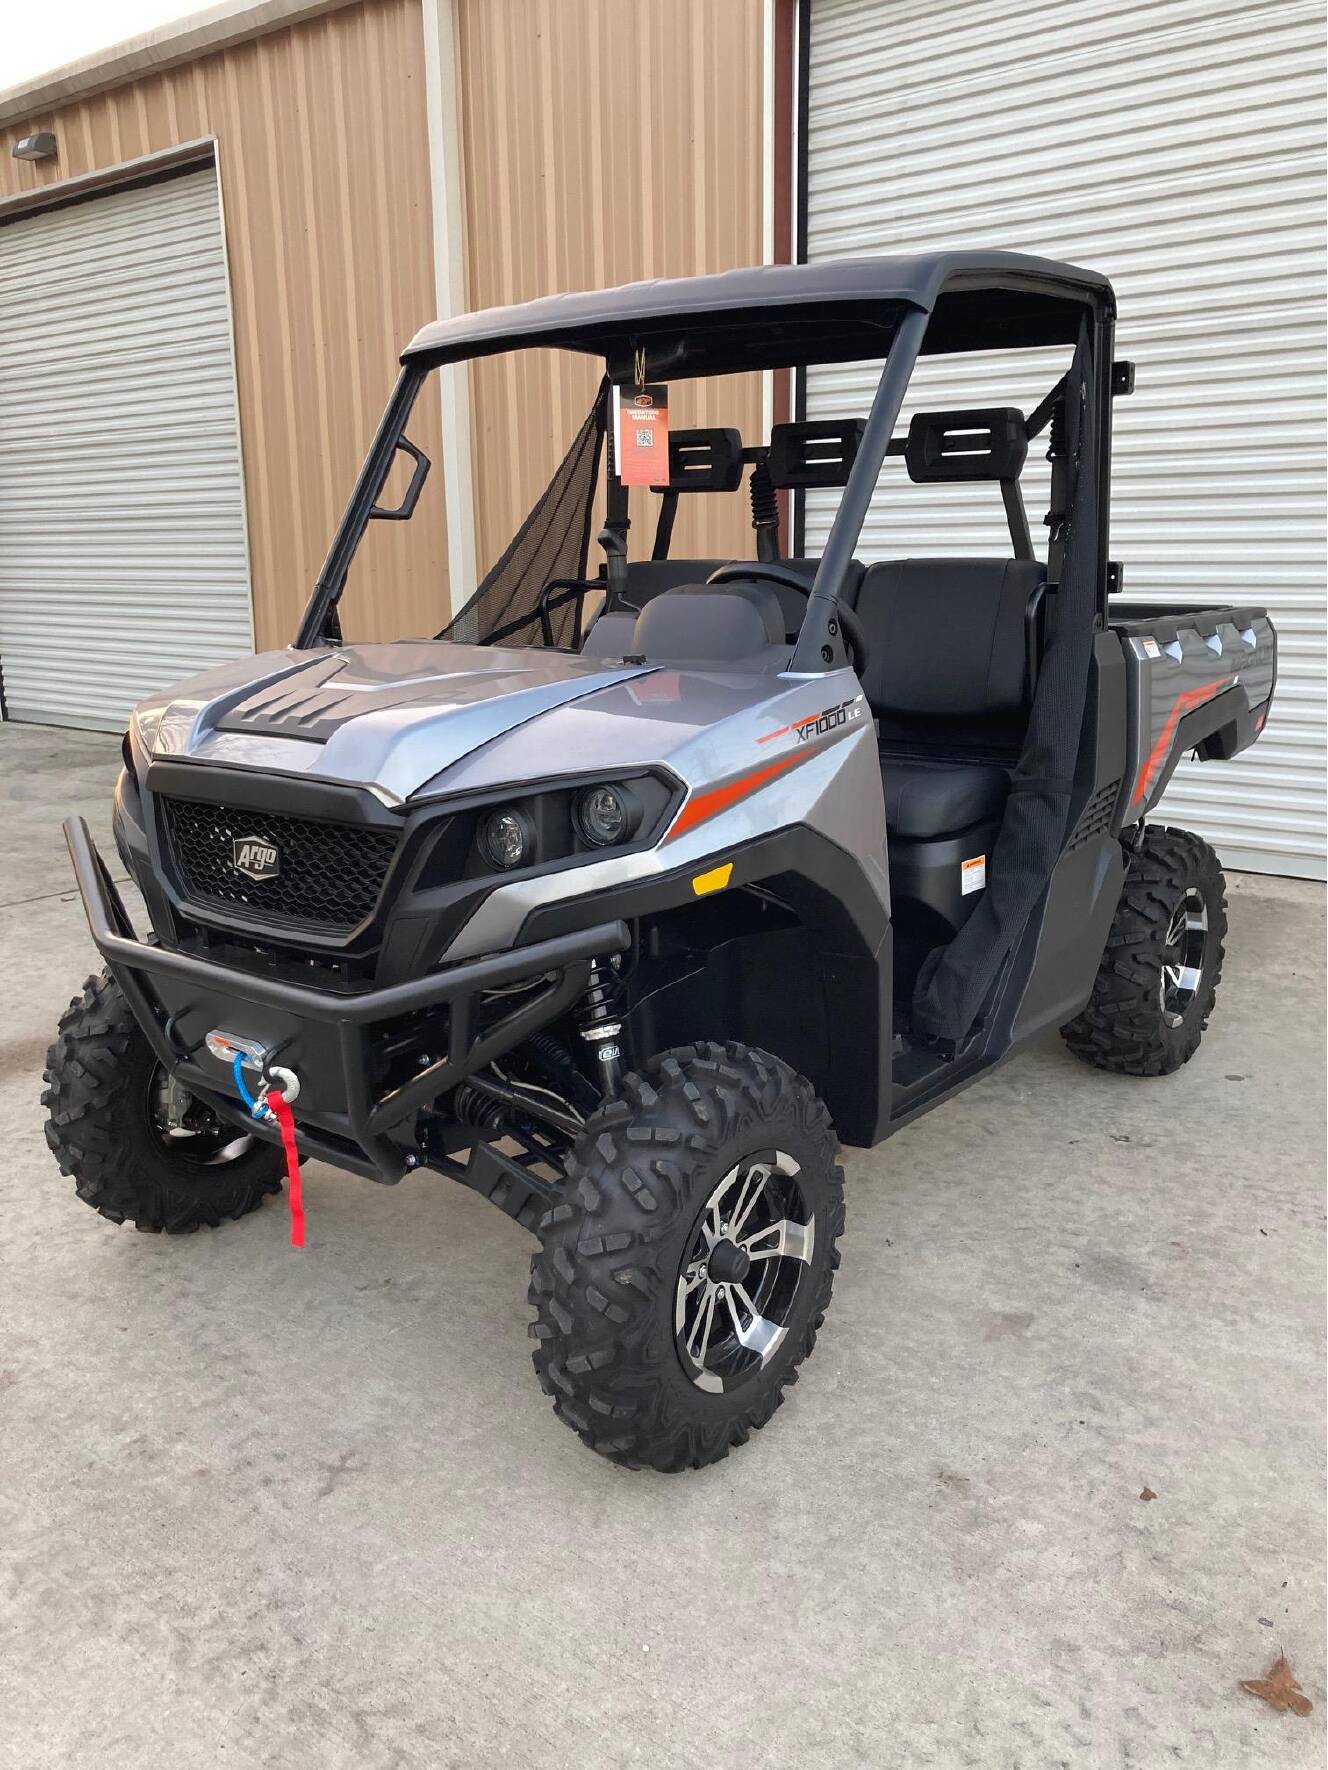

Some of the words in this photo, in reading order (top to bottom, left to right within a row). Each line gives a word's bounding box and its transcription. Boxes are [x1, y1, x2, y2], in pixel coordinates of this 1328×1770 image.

[796, 708, 847, 744] XF1000
[848, 708, 861, 720] LE
[237, 844, 277, 870] Argo
